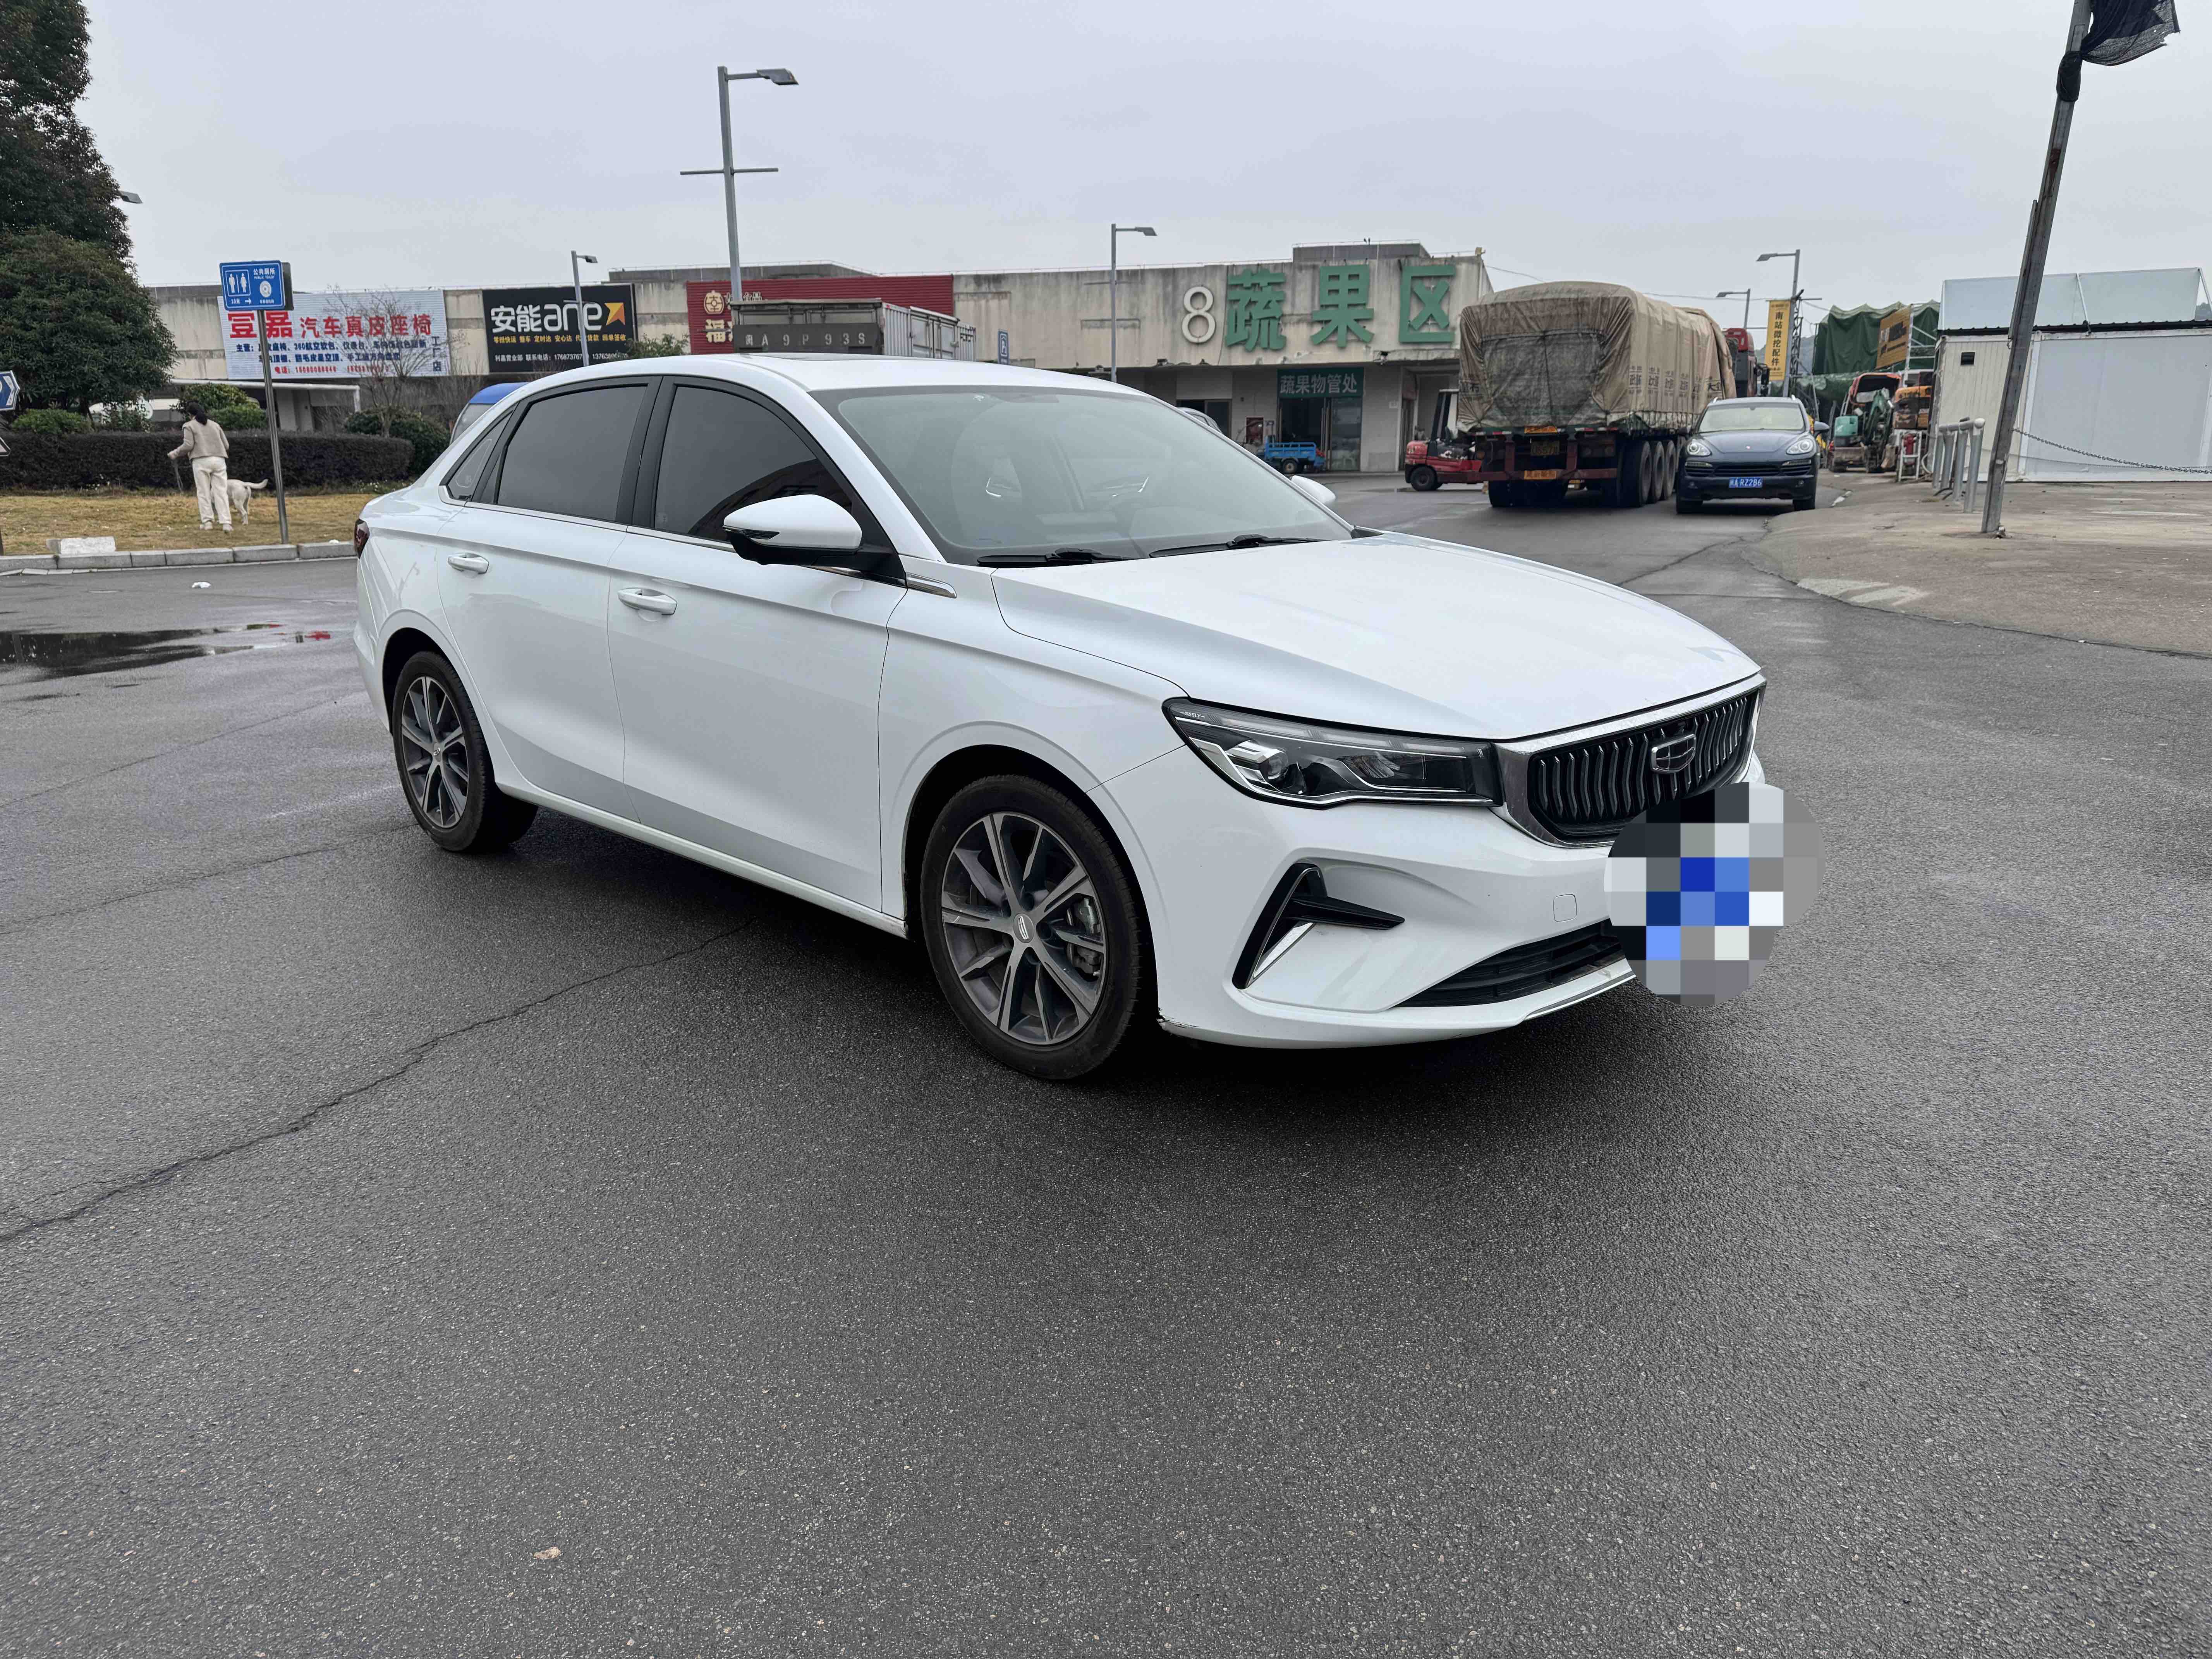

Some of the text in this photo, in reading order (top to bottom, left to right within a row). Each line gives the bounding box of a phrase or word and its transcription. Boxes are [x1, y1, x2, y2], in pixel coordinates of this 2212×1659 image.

[491, 302, 602, 333] 安能 ane
[1181, 265, 1456, 352] 8 蔬果区
[300, 314, 431, 338] 汽车真皮座椅
[431, 336, 441, 371] 工厂店
[1279, 373, 1357, 394] 蔬果物管处
